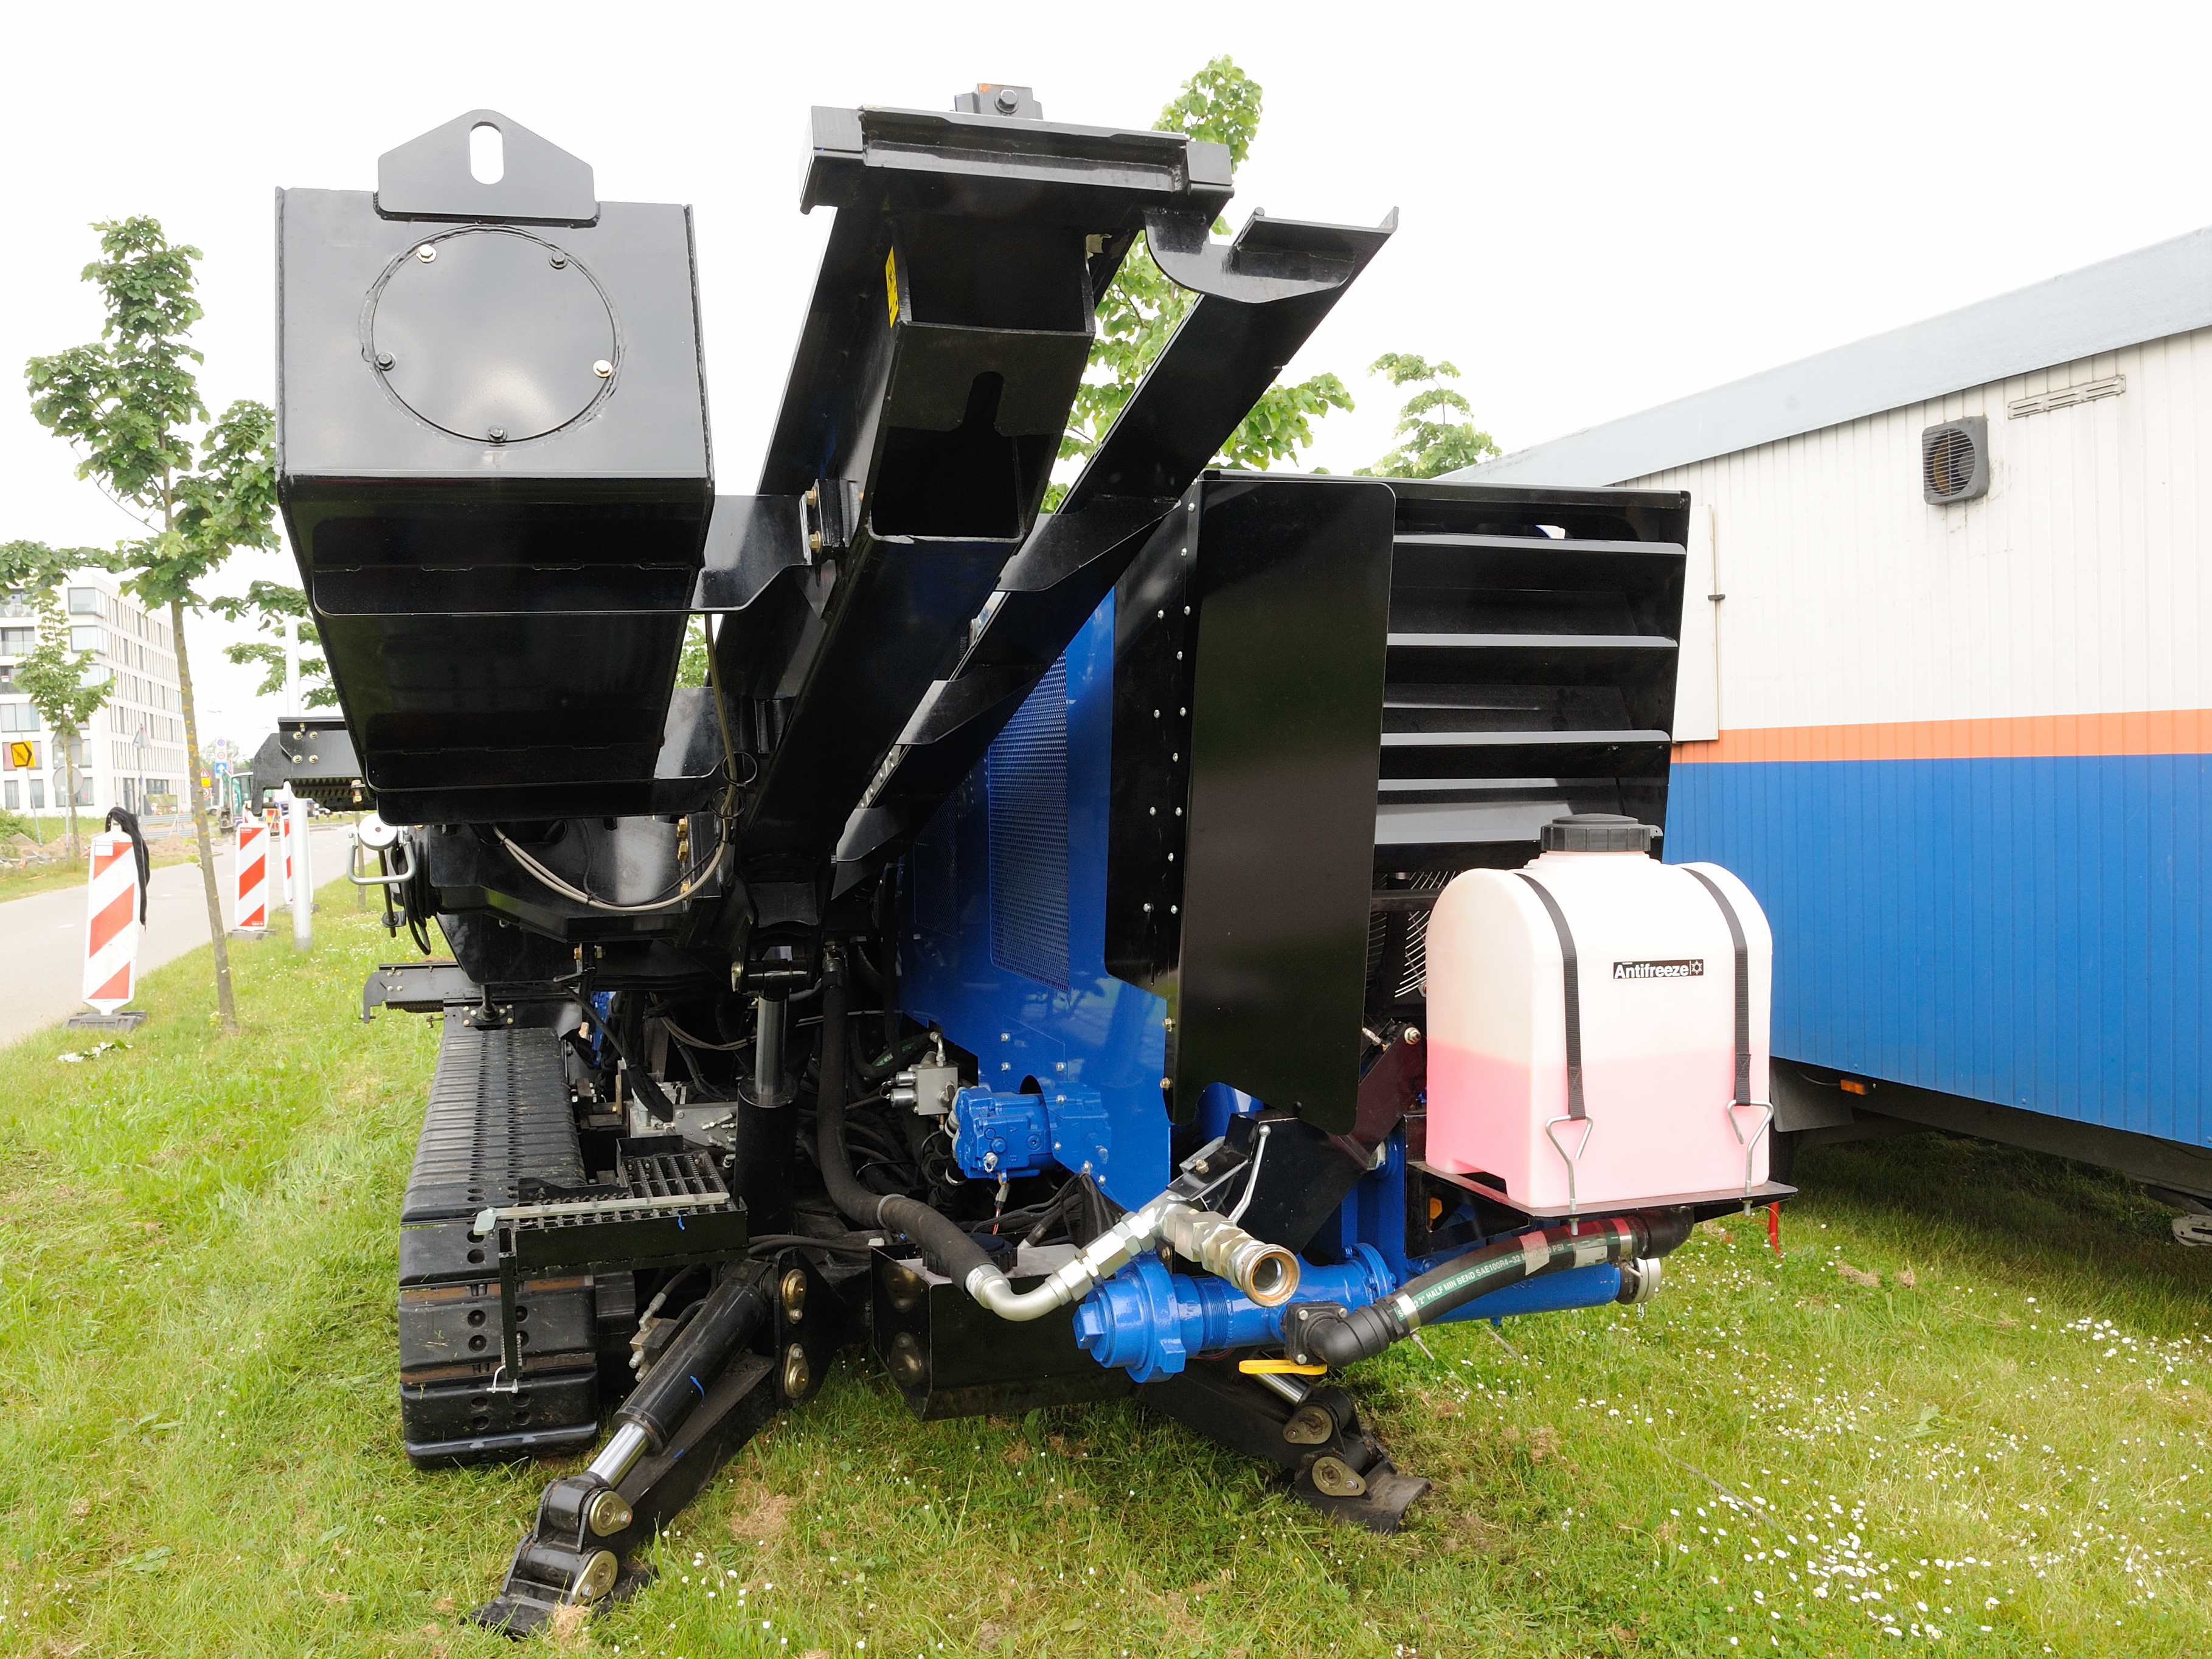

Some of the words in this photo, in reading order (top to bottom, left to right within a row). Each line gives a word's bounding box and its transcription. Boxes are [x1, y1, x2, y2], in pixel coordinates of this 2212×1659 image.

[1614, 963, 1689, 978] Antifreeze
[1426, 1286, 1443, 1300] HALF
[1443, 1280, 1457, 1291] MIN
[1457, 1272, 1475, 1284] BEND
[1475, 1255, 1521, 1276] SAE100R4-32
[1553, 1243, 1564, 1252] PSI
